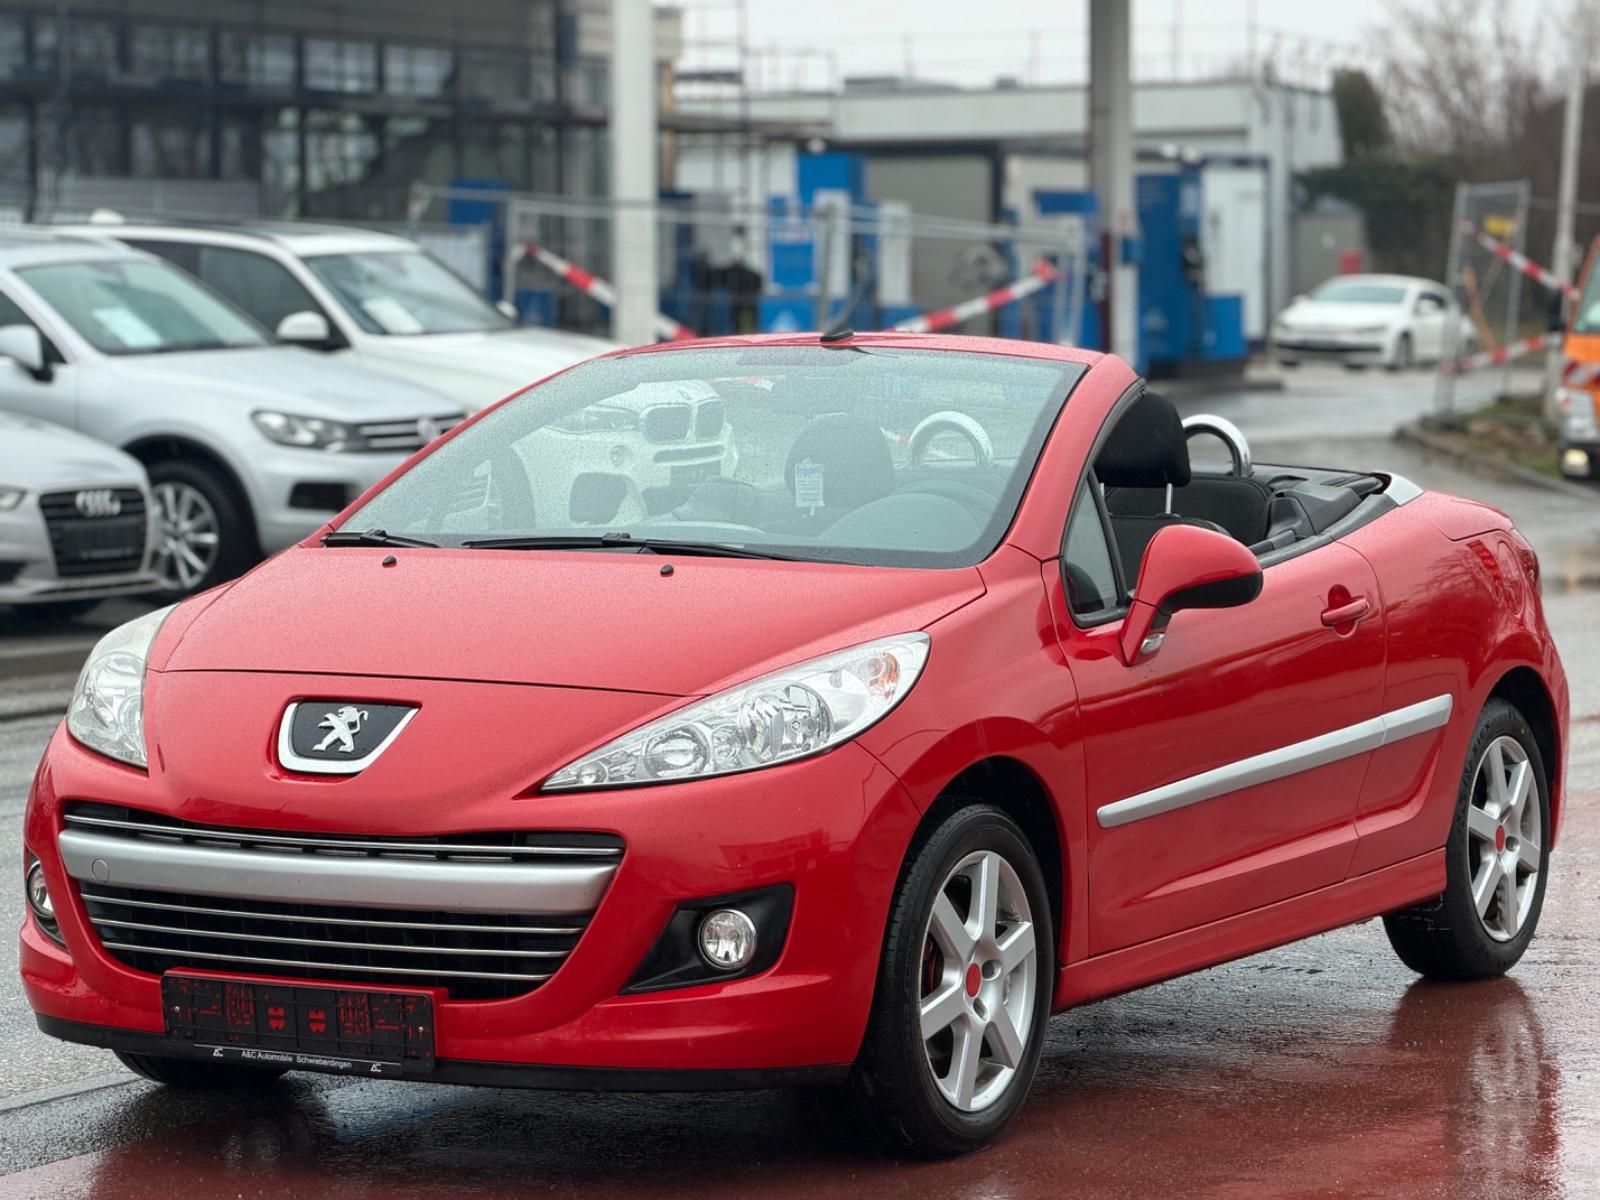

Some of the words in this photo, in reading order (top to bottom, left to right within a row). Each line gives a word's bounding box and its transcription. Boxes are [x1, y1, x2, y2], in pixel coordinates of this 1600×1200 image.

[241, 1050, 257, 1059] A&C
[257, 1050, 293, 1062] Automobile
[296, 1055, 352, 1069] Schwieberdingen
